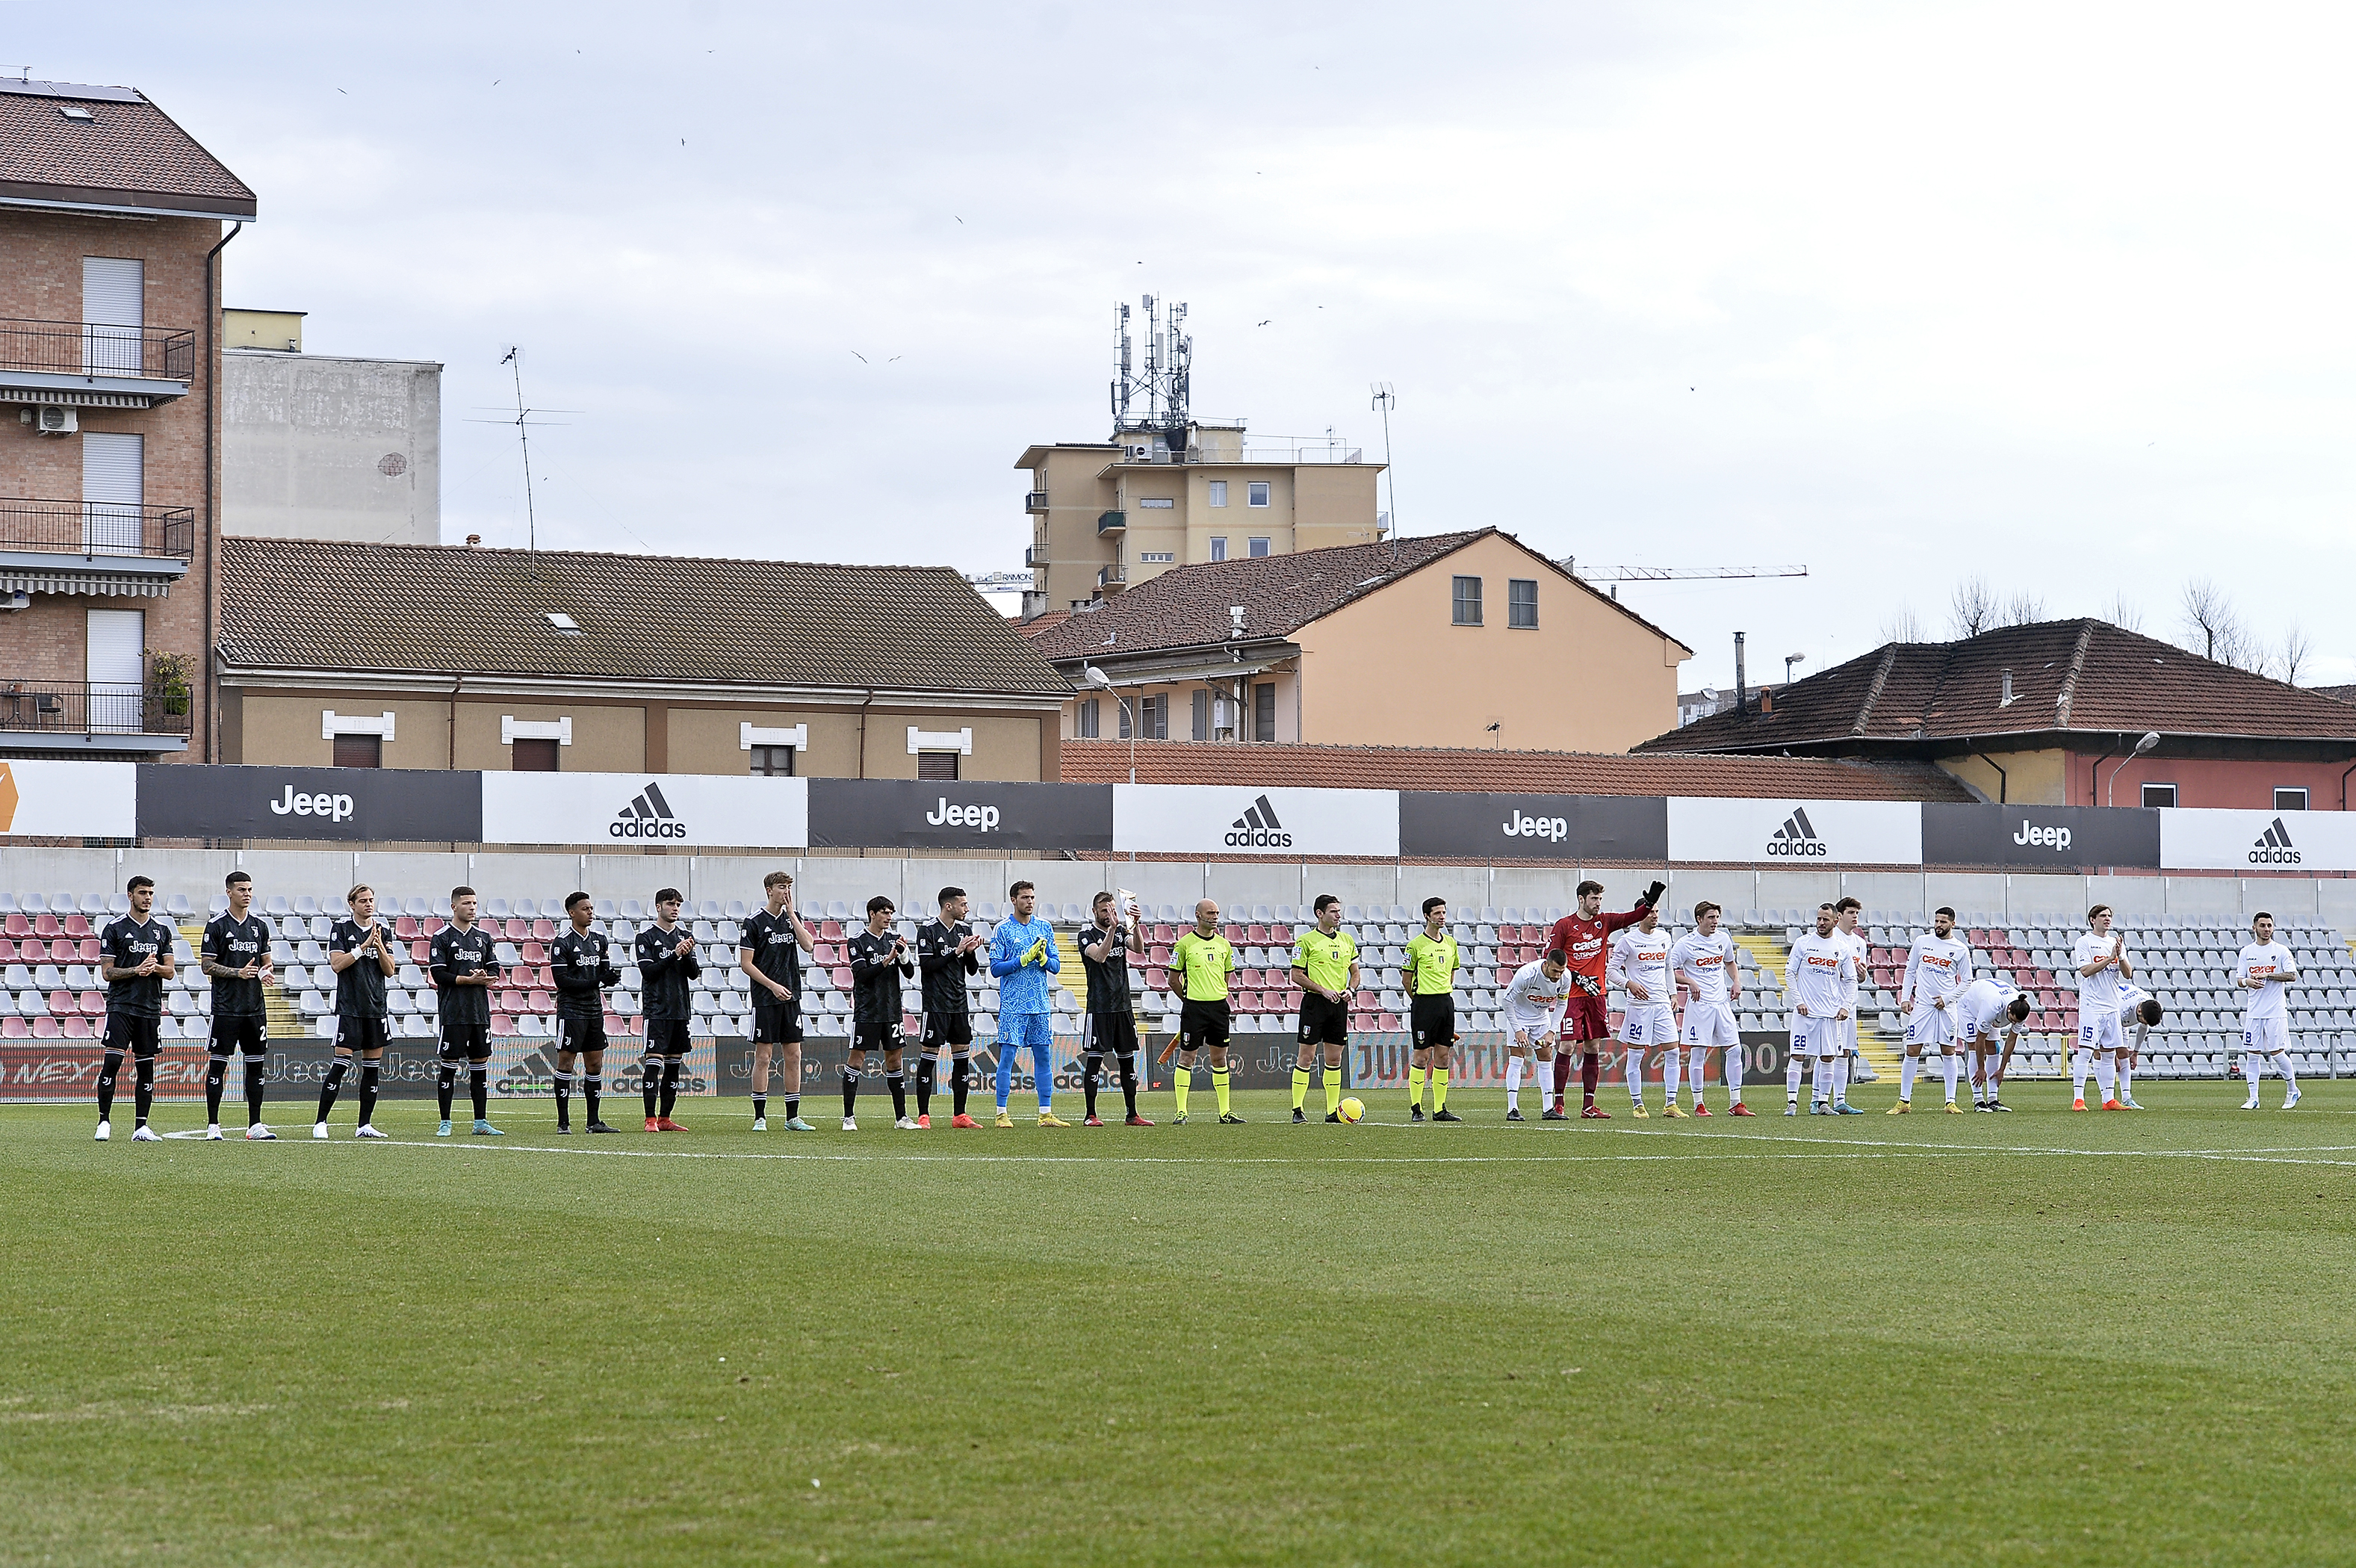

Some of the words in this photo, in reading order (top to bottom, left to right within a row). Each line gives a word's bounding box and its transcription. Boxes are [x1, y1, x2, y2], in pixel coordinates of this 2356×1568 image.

[271, 785, 353, 822] Jeep
[927, 798, 999, 831] Jeep
[610, 818, 686, 838] adidas
[1503, 810, 1568, 843] Jeep
[1224, 828, 1292, 848] adidas
[2014, 820, 2071, 852] Jeep
[1767, 838, 1826, 856] adidas
[2248, 847, 2301, 864] adidas
[769, 932, 793, 944] Jeep
[129, 940, 158, 954] Jeep
[229, 939, 258, 953] Jeep
[1109, 946, 1123, 957] eep
[455, 949, 482, 962] Jeep
[576, 954, 600, 967] Jeep
[1637, 952, 1667, 961] carer
[1696, 955, 1723, 967] carer
[1808, 956, 1838, 967] carer
[1922, 955, 1953, 967] carer
[2248, 965, 2276, 973] carer
[891, 1022, 904, 1038] 26
[1562, 1017, 1574, 1031] 12
[1629, 1023, 1643, 1038] 24
[1967, 1023, 1974, 1035] 9
[1690, 1026, 1696, 1038] 4
[2083, 1026, 2093, 1039] 15
[2245, 1032, 2252, 1043] 8
[1794, 1035, 1806, 1047] 28
